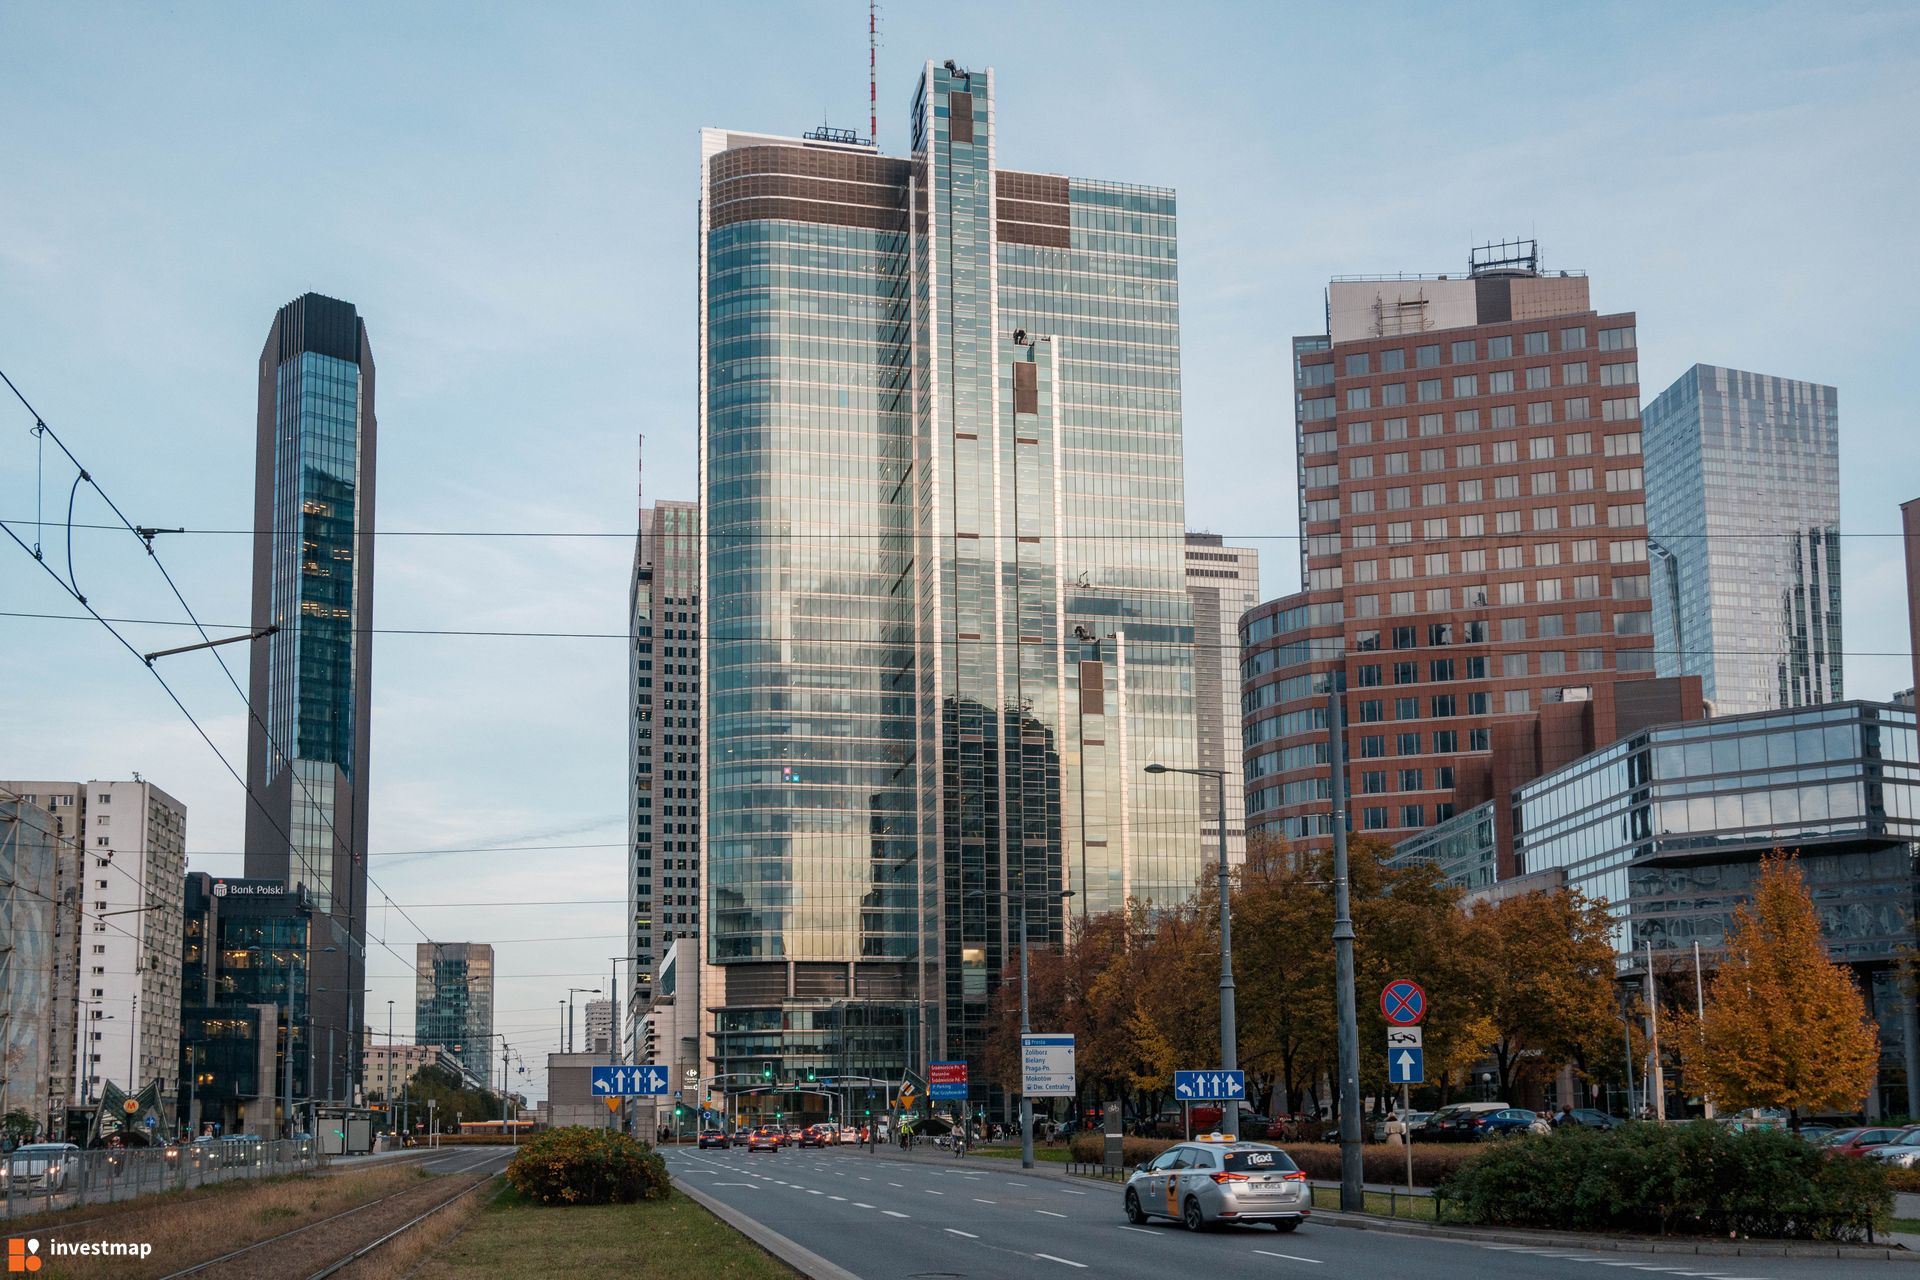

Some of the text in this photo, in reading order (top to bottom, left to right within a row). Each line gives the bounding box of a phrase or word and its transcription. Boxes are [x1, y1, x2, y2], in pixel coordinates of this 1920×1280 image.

[231, 885, 254, 894] Bank
[257, 885, 283, 894] Polski
[1247, 1153, 1272, 1165] iTaxi
